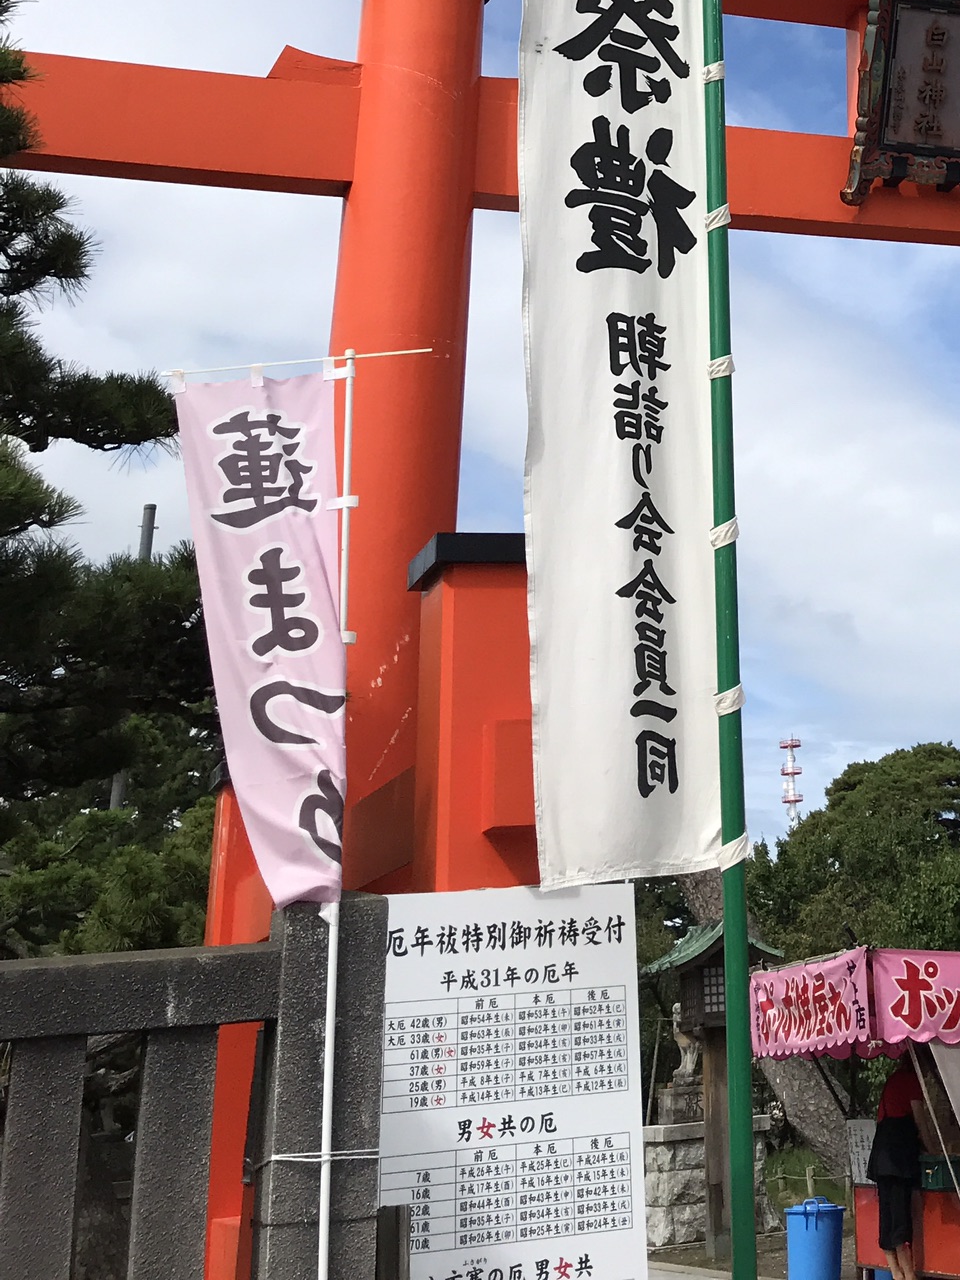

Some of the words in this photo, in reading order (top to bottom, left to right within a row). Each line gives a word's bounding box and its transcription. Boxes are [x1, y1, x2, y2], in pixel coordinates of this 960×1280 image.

[912, 20, 948, 138] 白山神社
[440, 961, 579, 993] 平成31年の厄年
[457, 1112, 557, 1143] 男女共の厄
